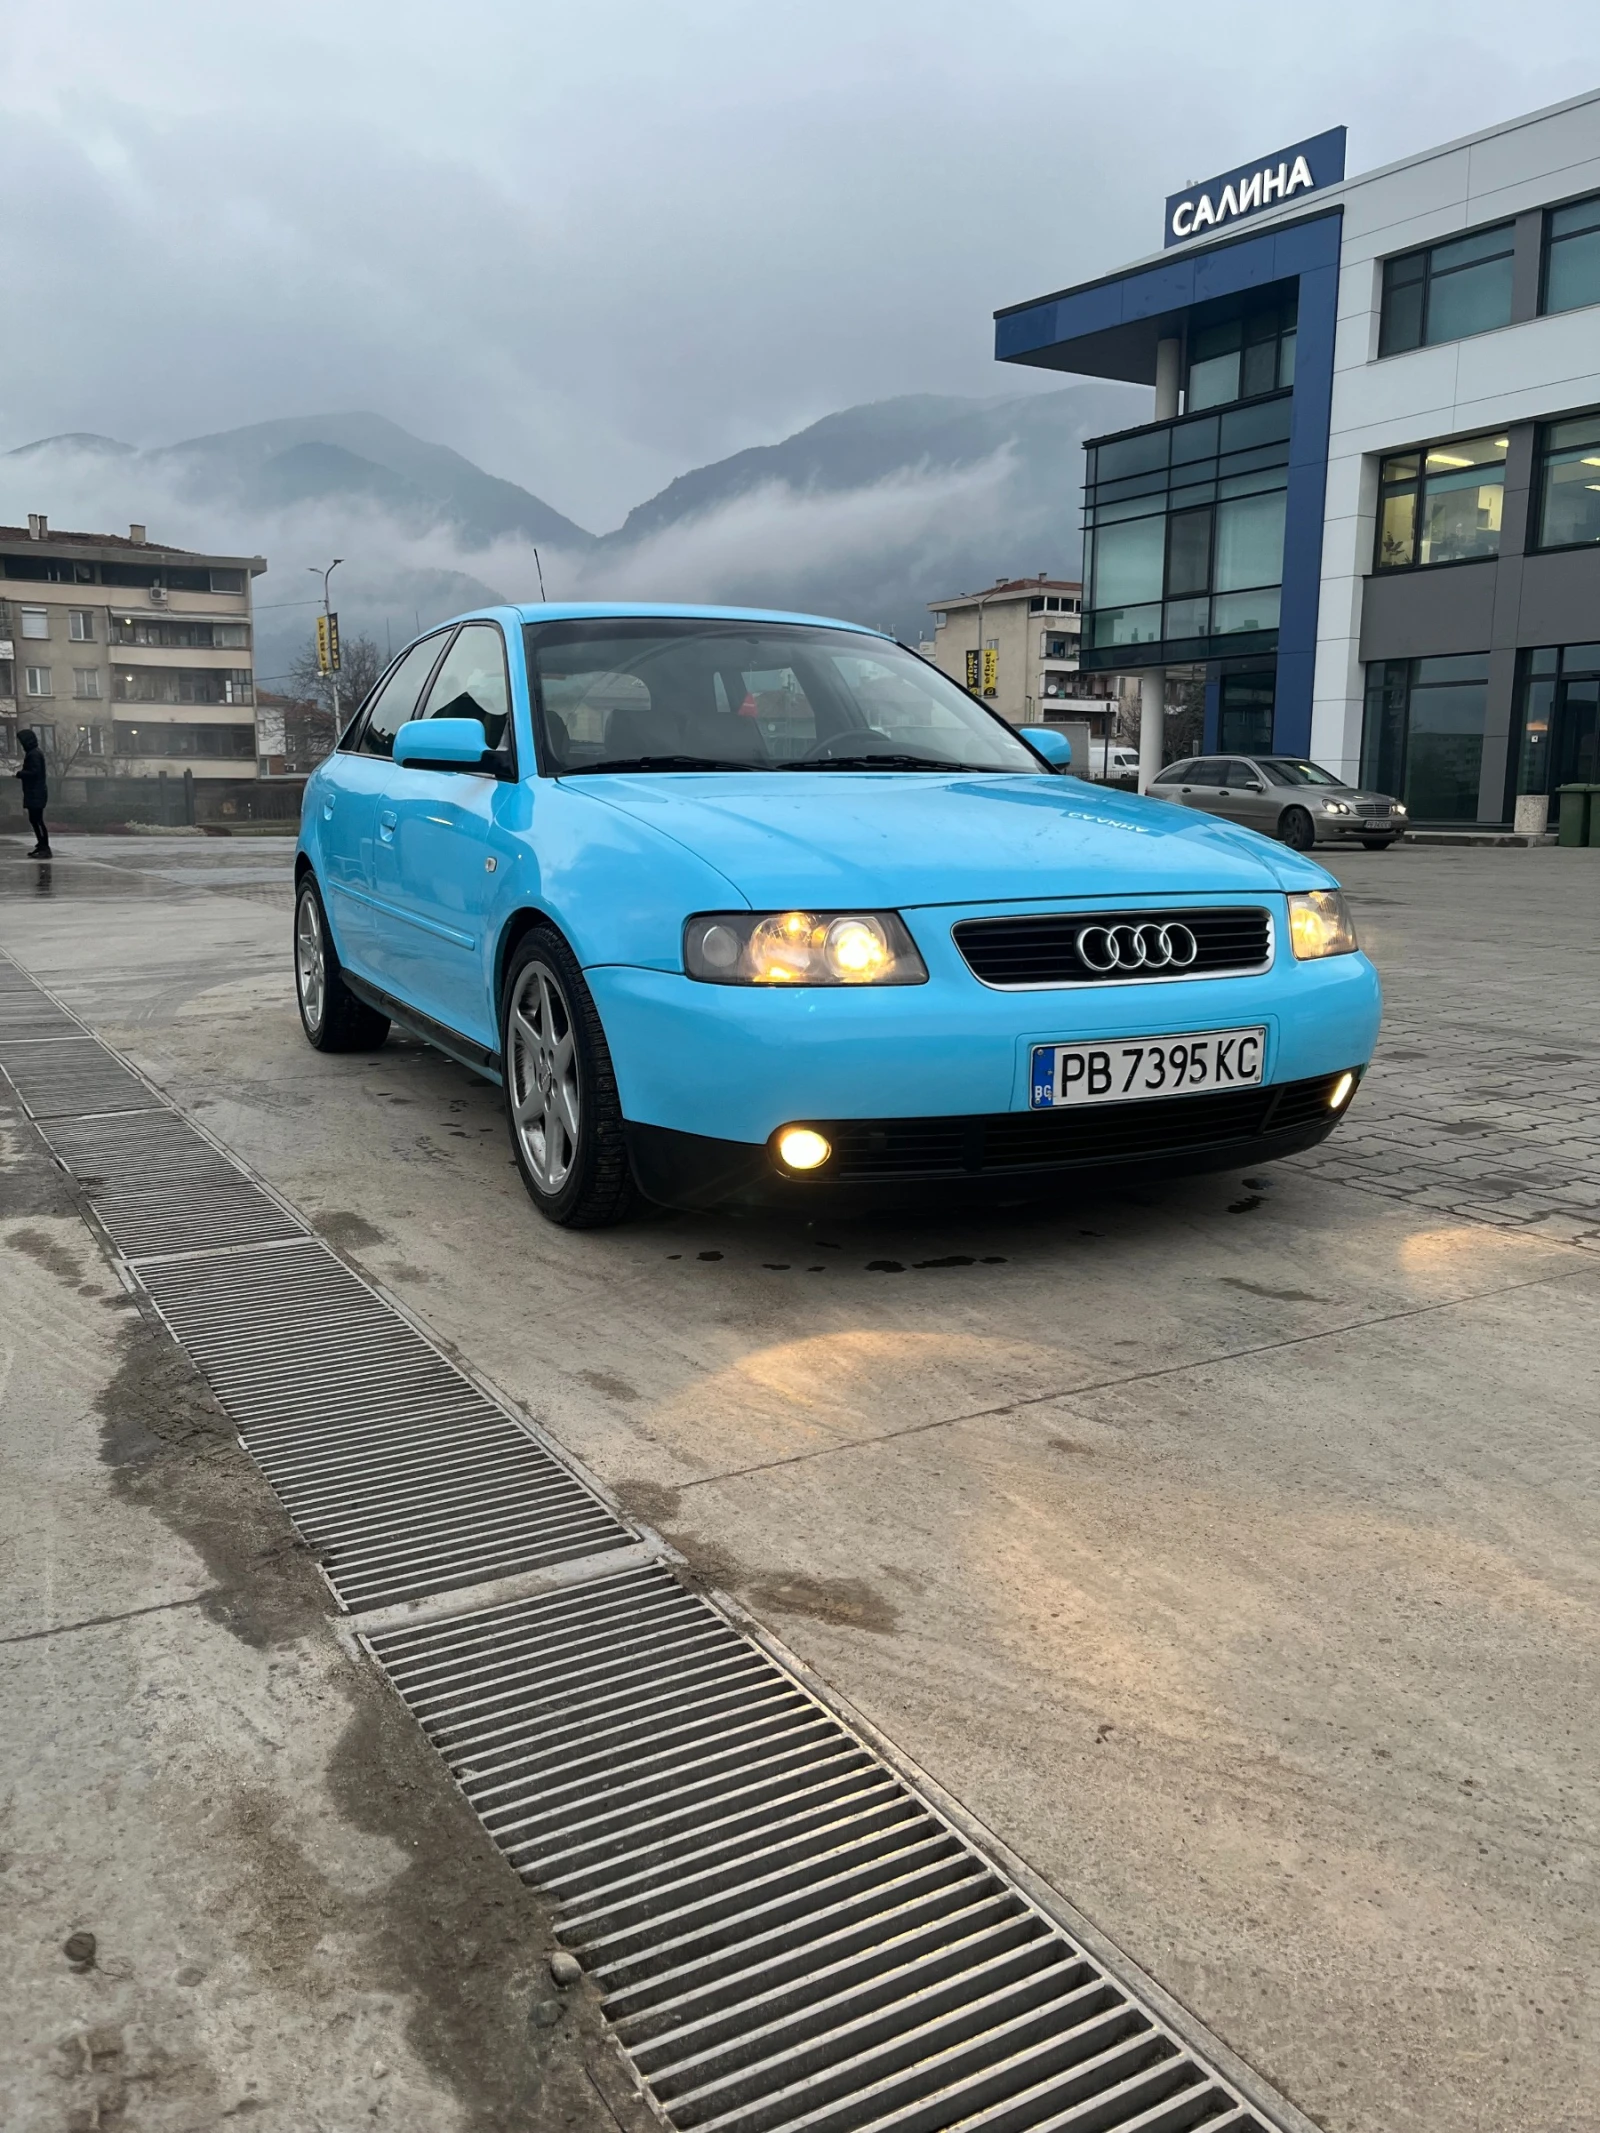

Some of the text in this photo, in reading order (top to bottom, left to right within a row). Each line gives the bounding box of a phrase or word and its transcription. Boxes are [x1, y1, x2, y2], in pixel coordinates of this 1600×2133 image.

[1172, 156, 1314, 236] САЛИНА
[1034, 1085, 1052, 1098] BG
[1121, 1043, 1208, 1093] 7395
